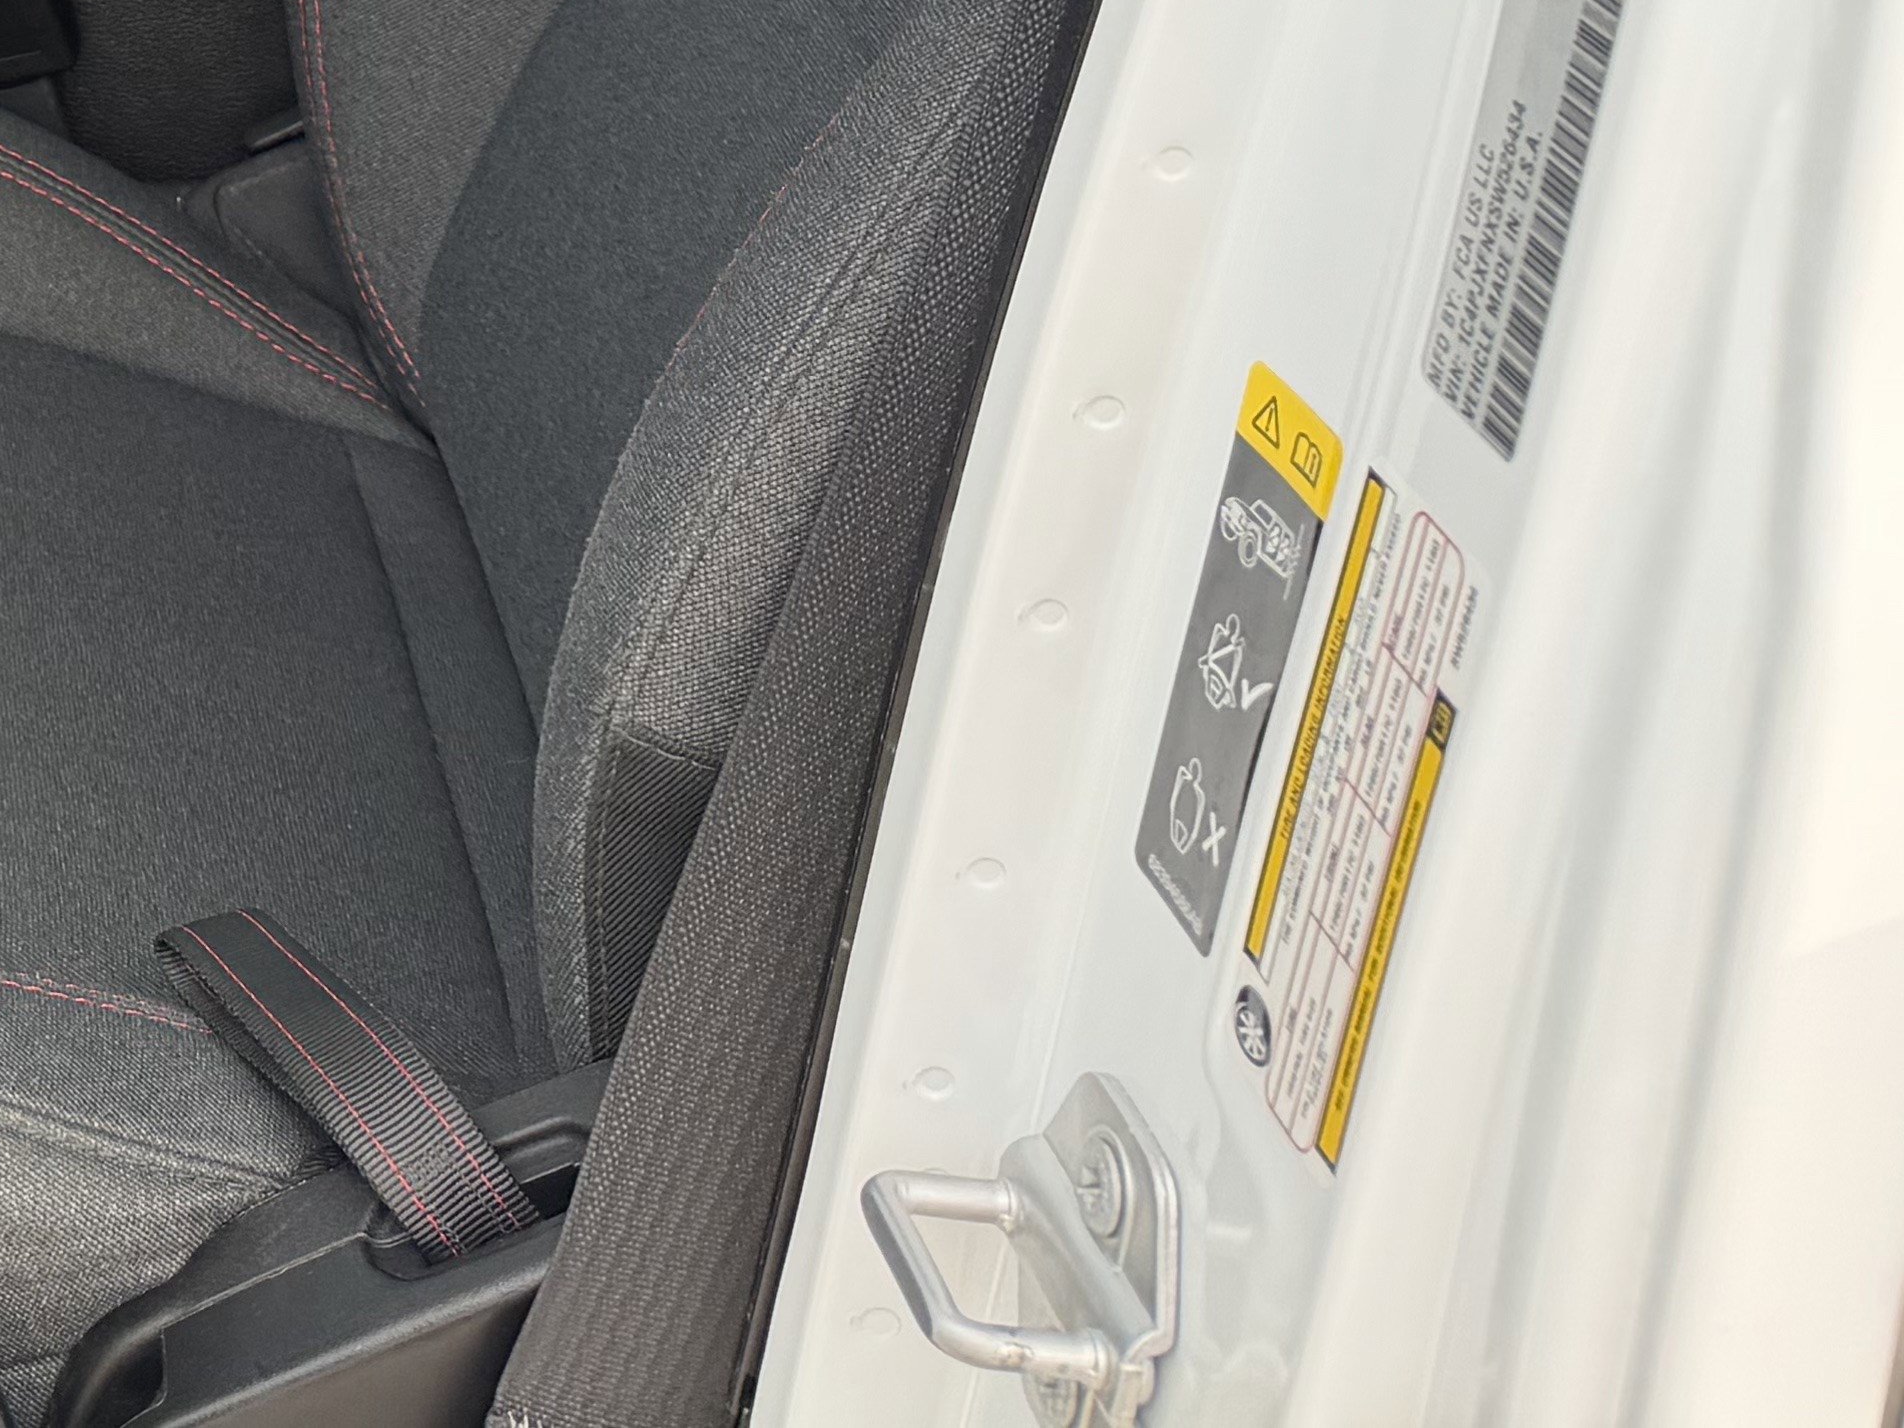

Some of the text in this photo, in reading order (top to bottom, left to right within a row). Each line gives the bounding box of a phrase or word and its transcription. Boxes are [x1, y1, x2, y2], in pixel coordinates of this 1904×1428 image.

[1427, 143, 1495, 388] MFD BY: FCA US LLC
[1443, 352, 1469, 405] VIN:
[1460, 130, 1543, 421] VEHICLE MADE IN: U.S.A.
